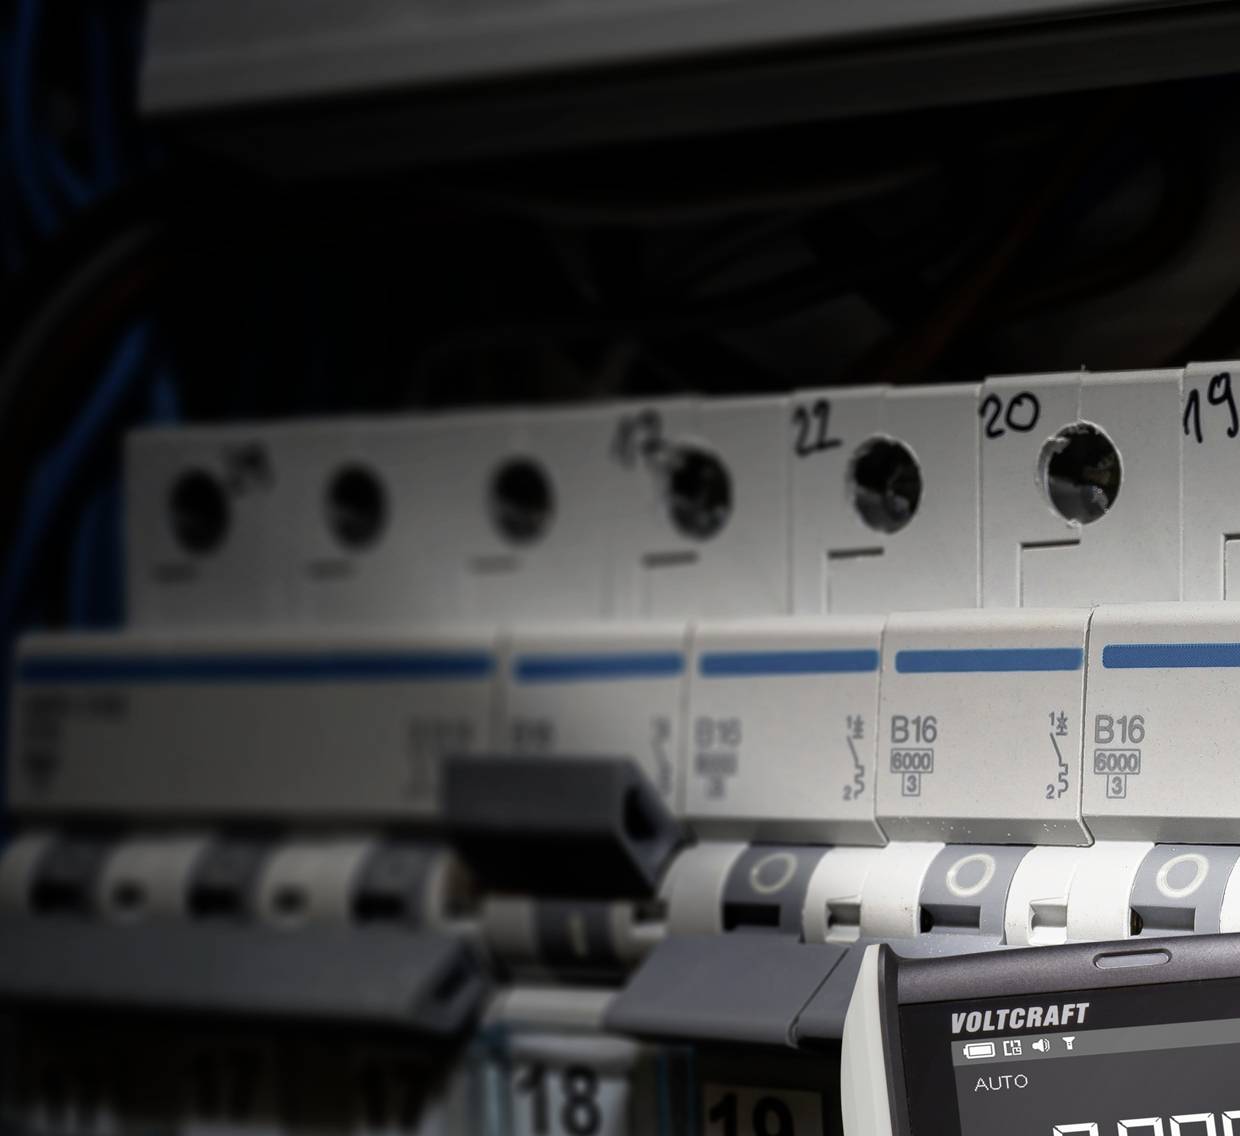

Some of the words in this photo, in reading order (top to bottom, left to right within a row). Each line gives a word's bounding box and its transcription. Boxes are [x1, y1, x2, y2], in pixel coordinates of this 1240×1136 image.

[978, 392, 1041, 439] 20
[1183, 372, 1239, 444] 19
[891, 715, 938, 744] B16
[1094, 715, 1146, 745] B16
[892, 752, 931, 770] 6000
[1095, 753, 1139, 772] 6000
[906, 775, 917, 793] 3
[1046, 784, 1055, 800] 2
[1111, 776, 1123, 795] 3
[951, 1002, 1090, 1034] VOLTCRAFT
[974, 1073, 1029, 1092] AUTO
